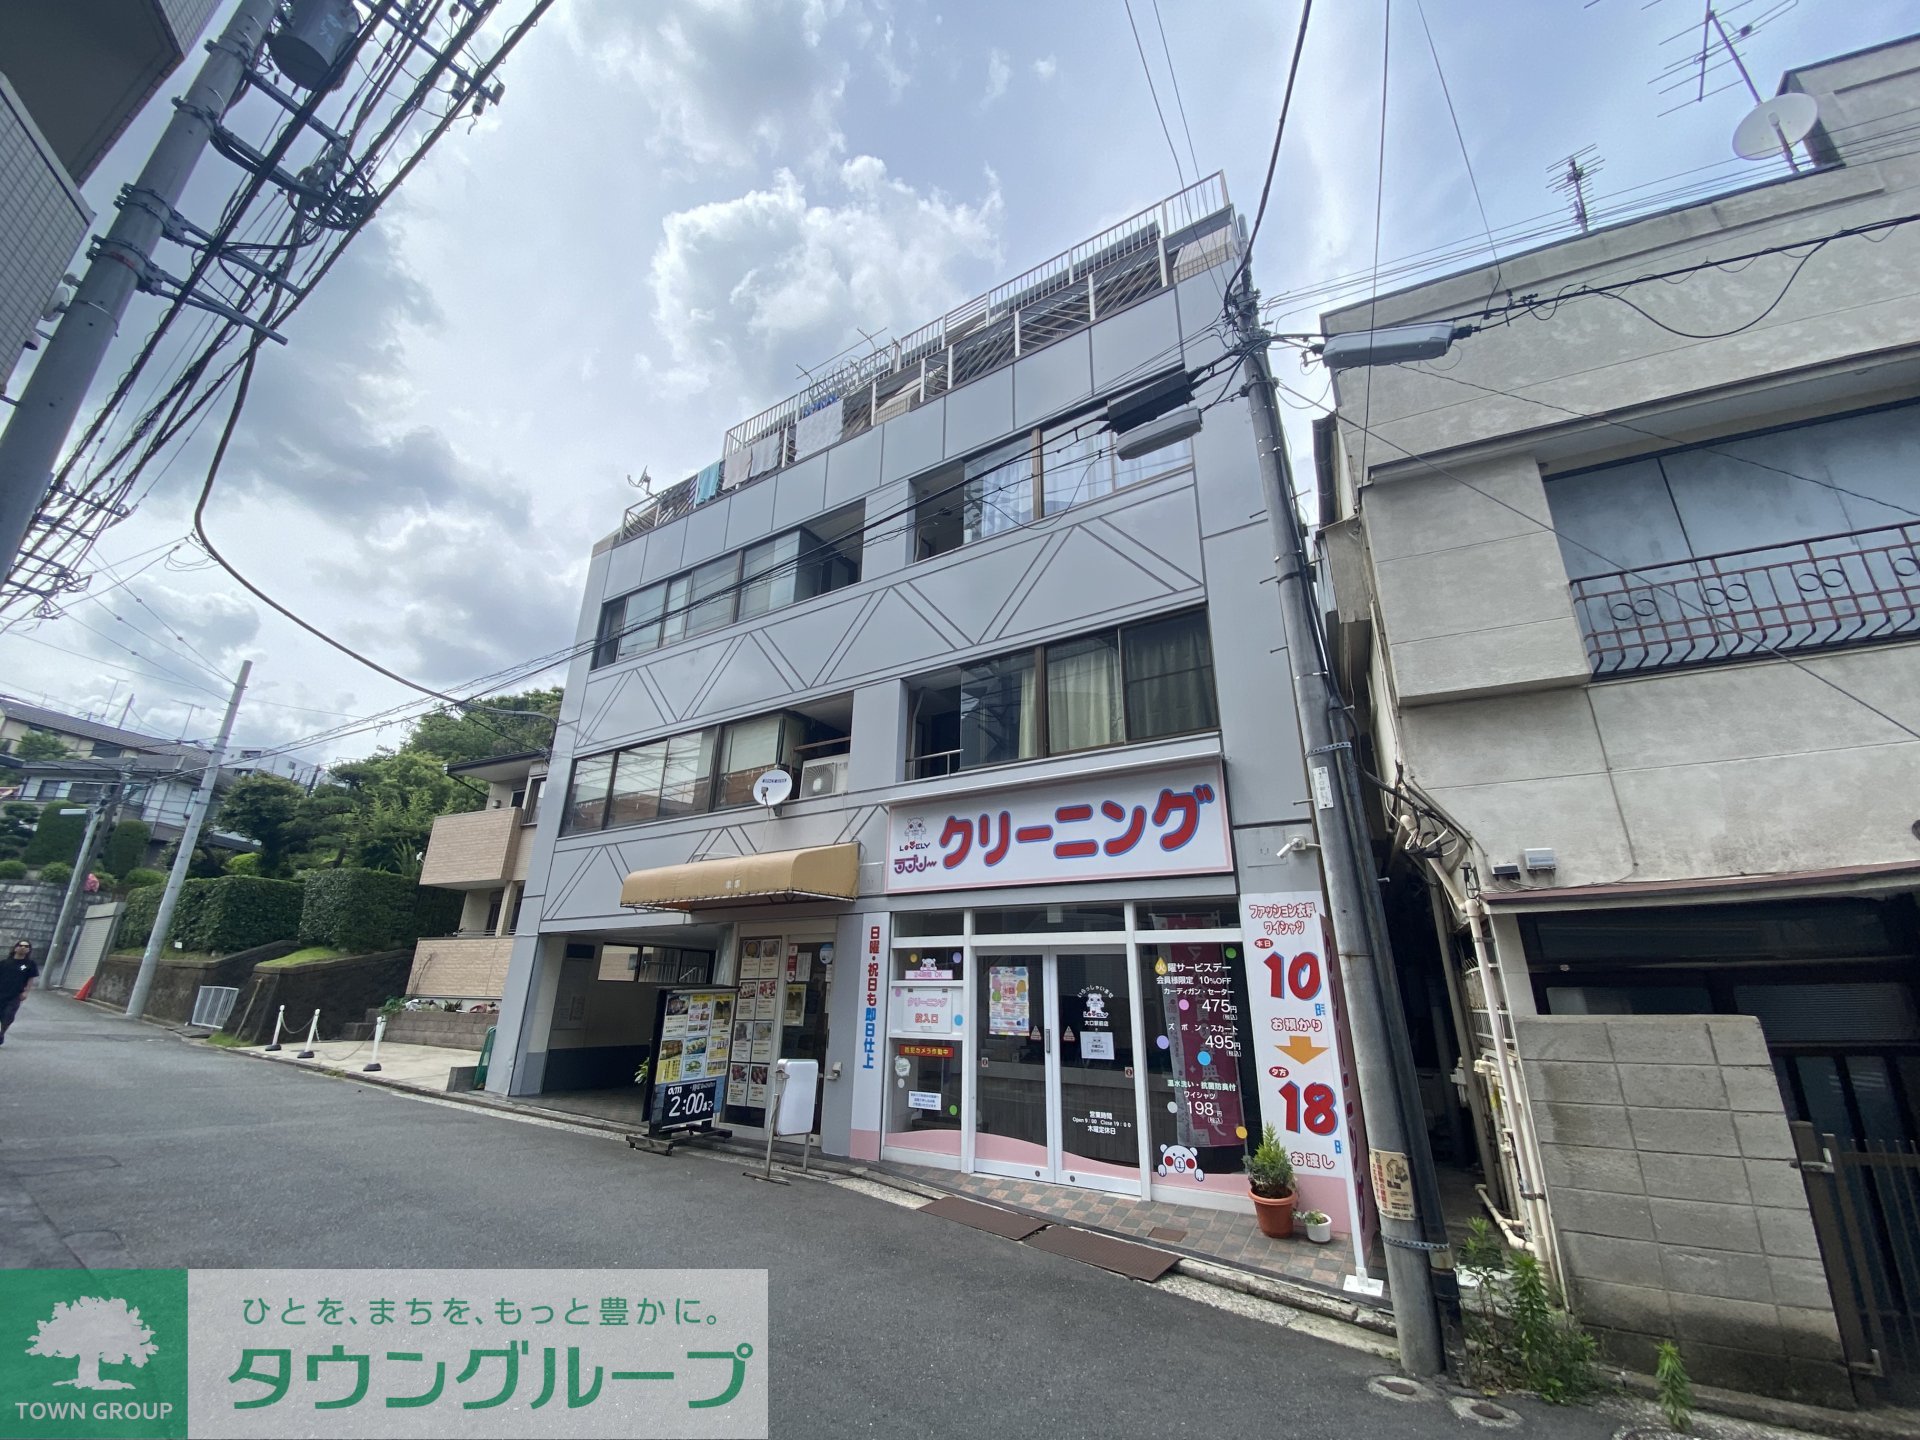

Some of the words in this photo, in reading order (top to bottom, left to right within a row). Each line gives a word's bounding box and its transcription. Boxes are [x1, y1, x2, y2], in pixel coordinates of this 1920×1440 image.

[940, 784, 1214, 869] クリーニング
[1264, 921, 1305, 935] ワイシャツ
[1156, 962, 1232, 973] 火曜サービスデー
[1263, 951, 1322, 1001] 10
[1164, 987, 1235, 995] カーディガン・セーター
[1271, 1018, 1322, 1032] お預かり
[1278, 1080, 1339, 1136] 18
[1291, 1151, 1335, 1169] お渡し
